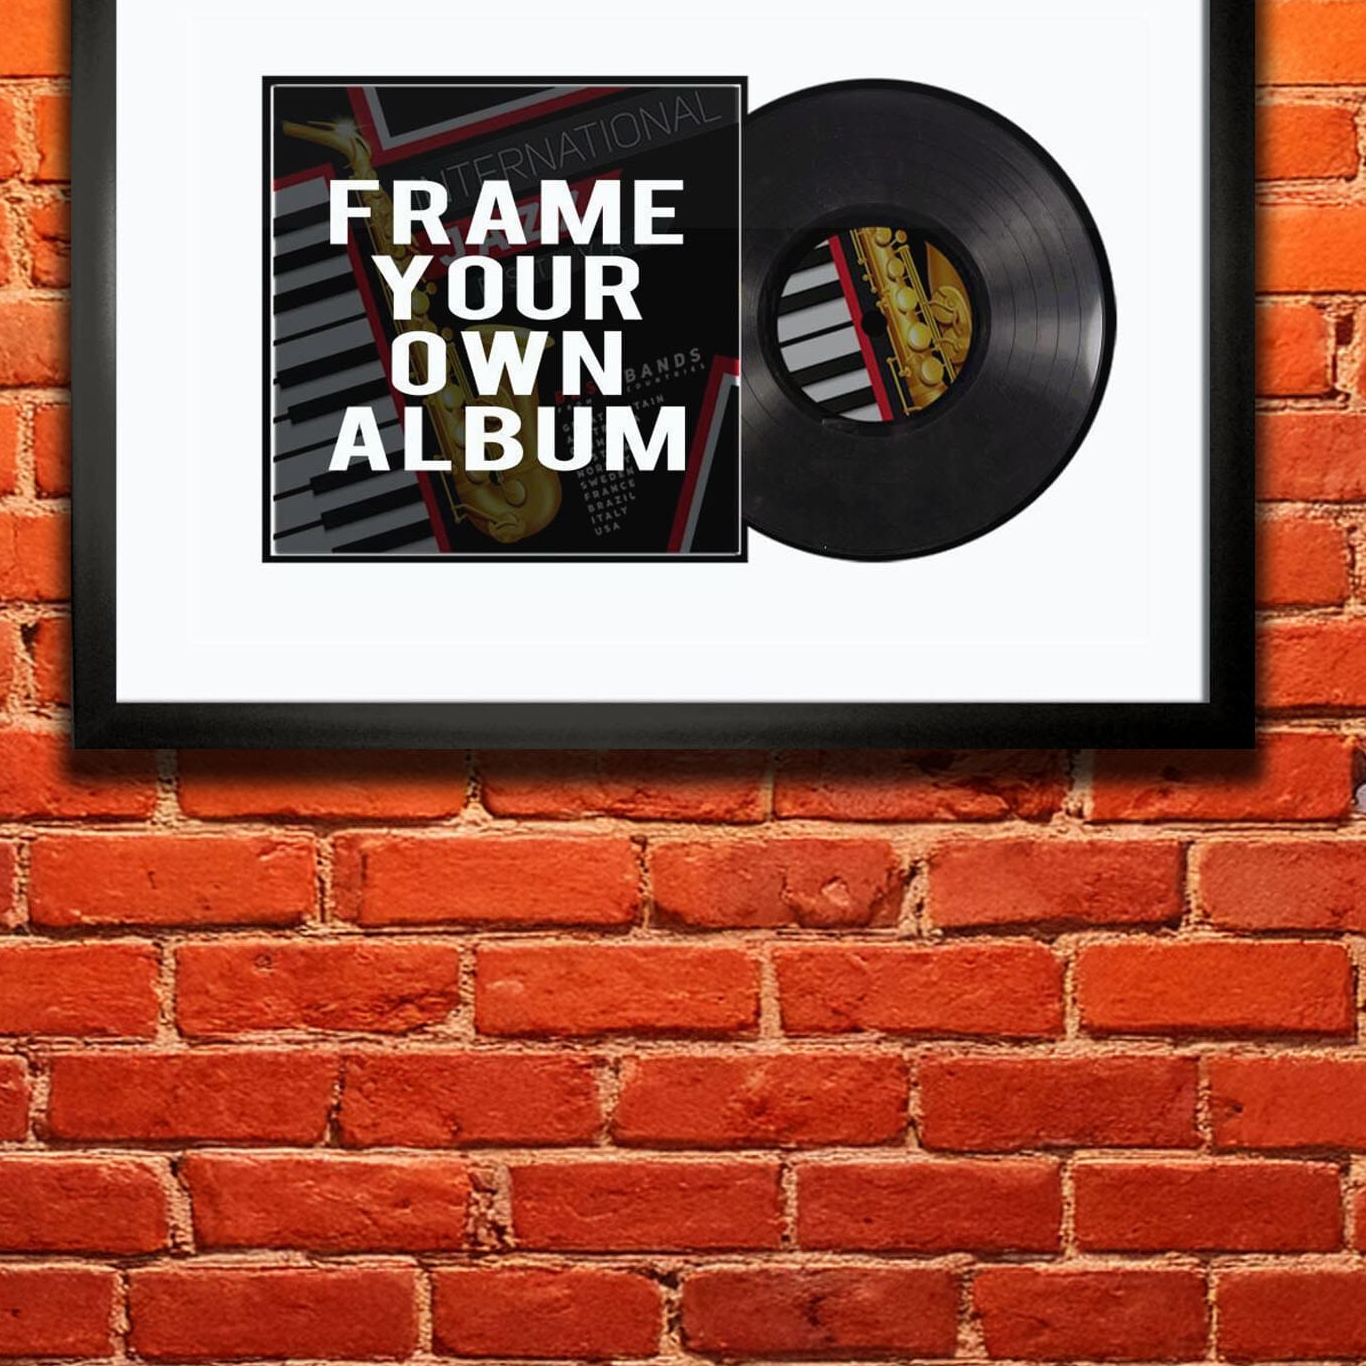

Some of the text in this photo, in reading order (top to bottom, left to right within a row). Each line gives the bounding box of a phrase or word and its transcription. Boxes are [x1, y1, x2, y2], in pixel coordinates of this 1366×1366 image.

[330, 179, 684, 245] FRAME
[438, 191, 579, 267] JAZ
[372, 255, 643, 321] YOUR
[391, 330, 622, 396] OWN
[625, 347, 701, 383] BANDS
[328, 406, 686, 471] ALBUM
[576, 453, 632, 479] NORY
[585, 478, 636, 502] FRANCE
[588, 491, 637, 513] BRAZIL
[592, 505, 628, 525] ITALY
[595, 521, 621, 536] USA
